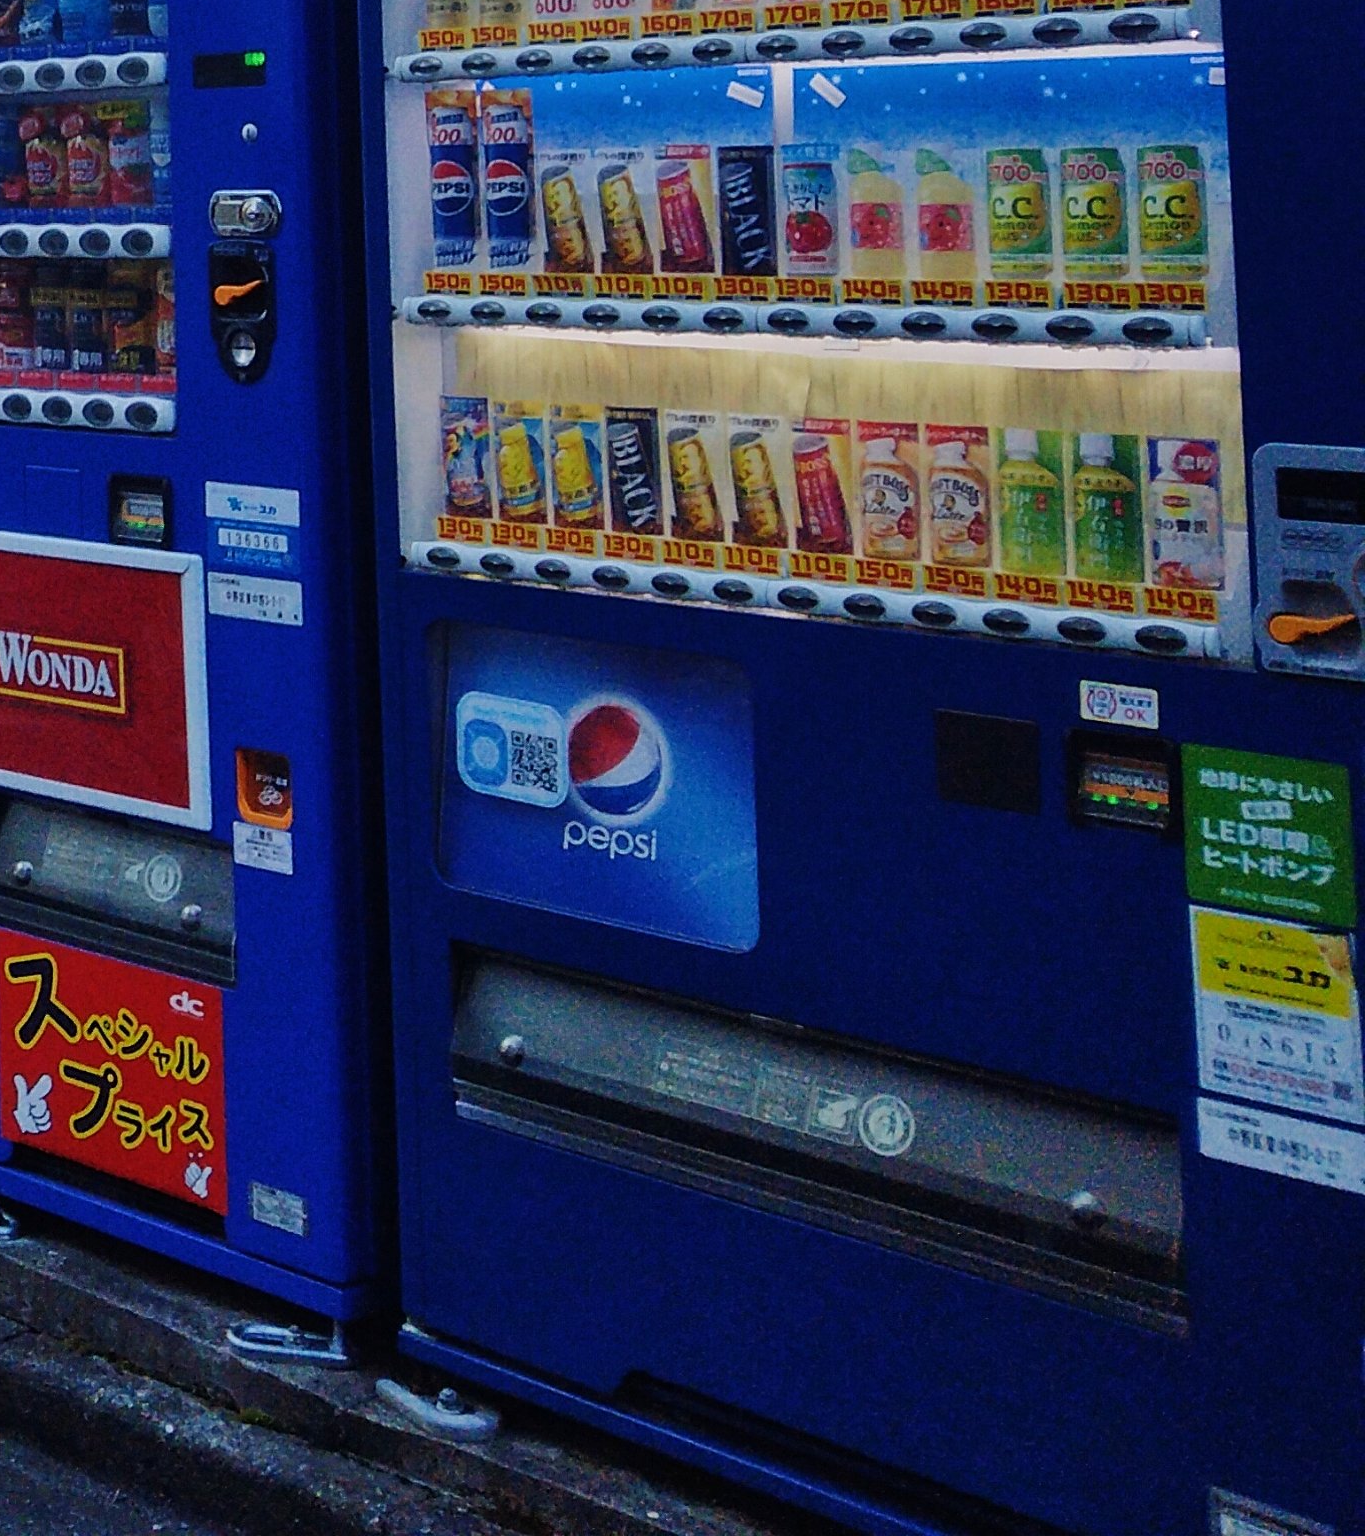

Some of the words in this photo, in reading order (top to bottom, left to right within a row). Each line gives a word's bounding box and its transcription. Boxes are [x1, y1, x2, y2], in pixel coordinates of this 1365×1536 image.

[700, 10, 753, 28] 170円
[765, 6, 821, 25] 170円
[831, 0, 889, 19] 170円
[527, 22, 576, 39] 140円
[580, 19, 630, 36] 140円
[641, 15, 693, 33] 160円
[420, 30, 465, 47] 150円
[471, 25, 517, 43] 150円
[724, 180, 772, 270] BLACK
[426, 272, 472, 290] 150円
[479, 274, 526, 291] 150円
[534, 275, 584, 292] 110円
[595, 276, 644, 293] 110円
[652, 277, 703, 295] 110円
[714, 277, 768, 296] 130円
[775, 279, 831, 296] 130円
[842, 280, 901, 298] 140円
[911, 281, 973, 299] 140円
[985, 282, 1049, 300] 130円
[1065, 283, 1130, 302] 130円
[1134, 284, 1205, 303] 130円
[612, 438, 657, 529] BLACK
[438, 517, 483, 536] 130円
[491, 523, 538, 543] 130円
[546, 529, 595, 549] 130円
[603, 535, 654, 555] 130円
[663, 541, 715, 560] 110円
[724, 547, 778, 567] 110円
[791, 554, 846, 574] 110円
[856, 560, 913, 581] 150円
[925, 566, 985, 588] 150円
[994, 574, 1058, 598] 140円
[1066, 581, 1133, 605] 140円
[1144, 588, 1214, 612] 140円
[561, 820, 658, 862] pepsi
[1202, 844, 1337, 886] ヒートポンプ
[3, 951, 211, 1086] スペシャル
[58, 1058, 215, 1154] プライス
